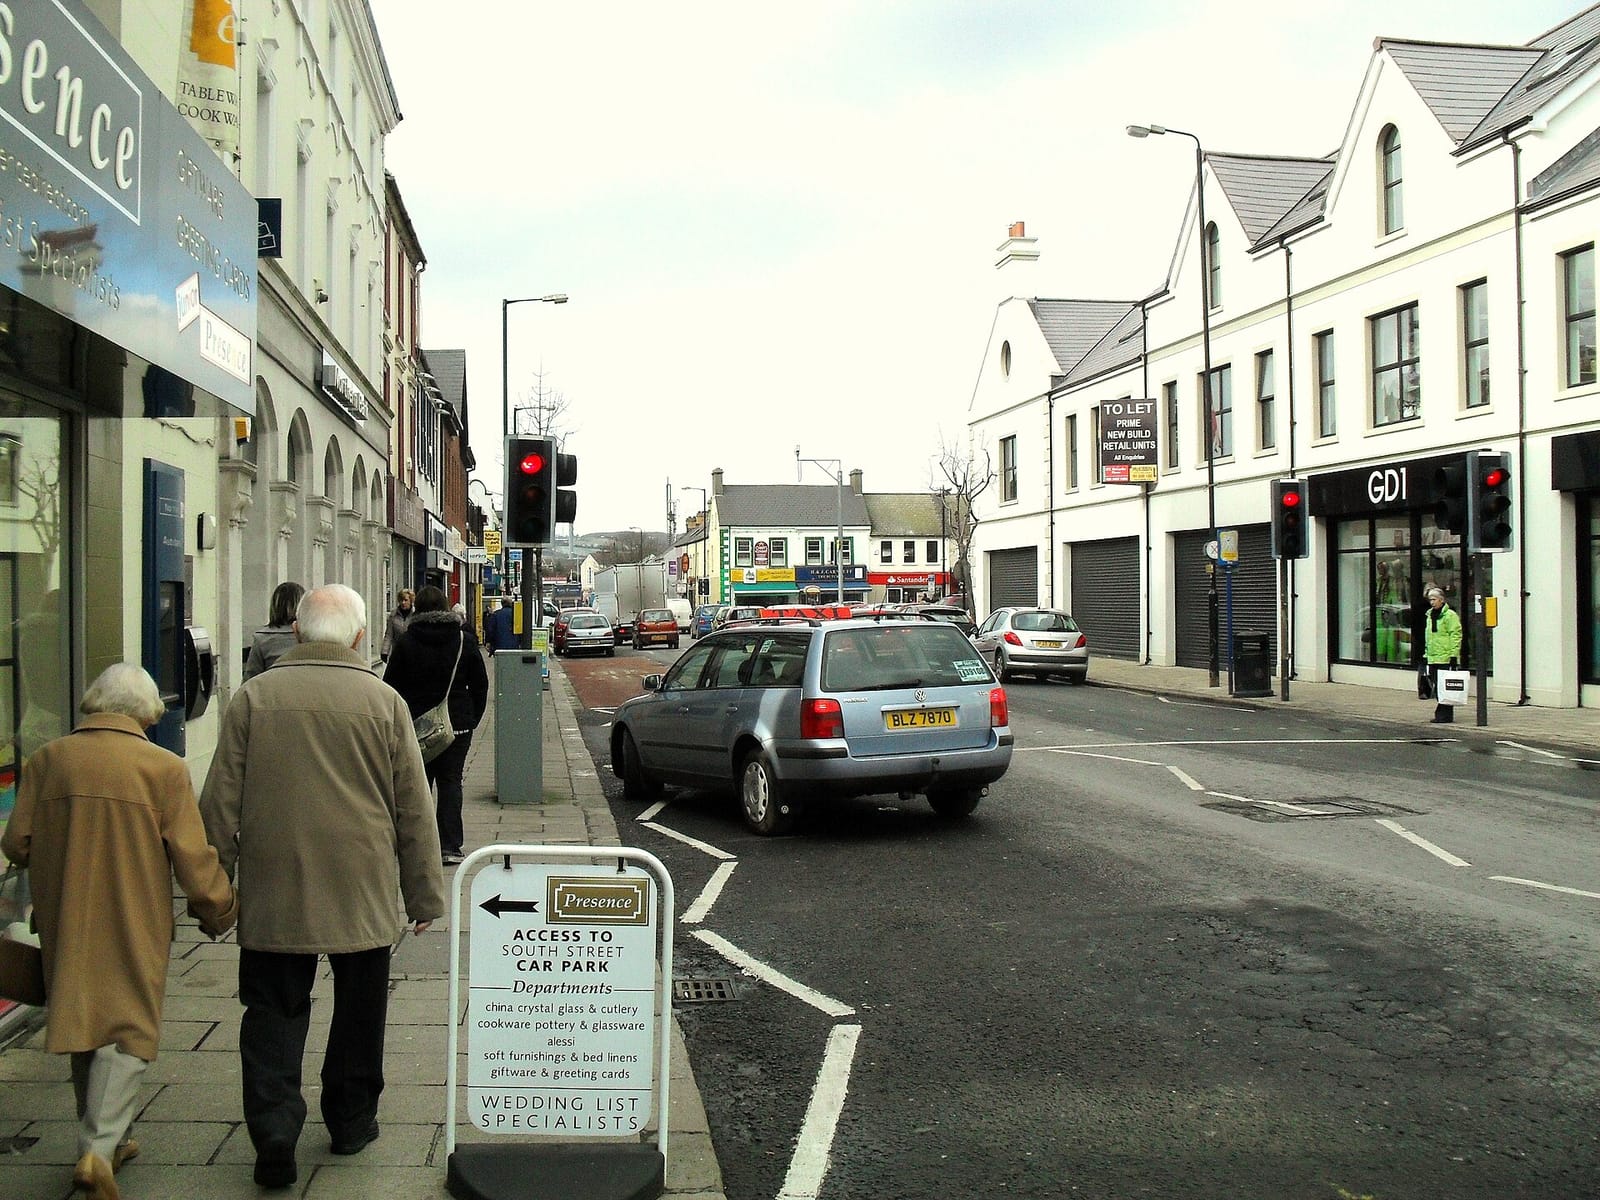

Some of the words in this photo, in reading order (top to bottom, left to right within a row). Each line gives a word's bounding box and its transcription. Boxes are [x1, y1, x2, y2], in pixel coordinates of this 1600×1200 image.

[180, 81, 238, 106] TABLEW
[176, 214, 221, 278] GREETING
[223, 256, 251, 302] CARDS
[28, 220, 121, 311] Specialists
[1104, 404, 1123, 415] TO
[1127, 402, 1154, 414] LET
[1116, 419, 1141, 428] PRIME
[1107, 430, 1126, 440] NEW
[1127, 430, 1151, 438] BUILD
[1103, 442, 1131, 450] RETAIL
[1132, 440, 1156, 450] UNITS
[896, 576, 929, 584] Santander
[772, 608, 838, 619] TAXI
[891, 713, 917, 727] BLZ
[919, 710, 951, 724] 7870
[563, 893, 632, 909] Presence
[513, 930, 581, 942] ACCESS
[589, 930, 613, 942] TO
[502, 944, 558, 957] SOUTH
[567, 946, 624, 958] STREET
[516, 960, 553, 972] CAR
[562, 960, 609, 973] PARK
[512, 980, 613, 997] Departments
[485, 1002, 513, 1012] china
[518, 1003, 554, 1015] crystal
[558, 1003, 584, 1016] glass
[588, 1004, 597, 1014] &
[601, 1003, 639, 1017] cutlery
[478, 1019, 531, 1030] cookware
[535, 1021, 576, 1032] pottery
[580, 1021, 588, 1030] &
[592, 1020, 645, 1033] glassware
[547, 1036, 576, 1047] alessi
[484, 1050, 505, 1061] soft
[510, 1051, 566, 1064] furnishings
[570, 1053, 579, 1062] &
[583, 1052, 603, 1063] bed
[608, 1052, 638, 1063] linens
[490, 1067, 536, 1079] giftware
[541, 1068, 549, 1078] &
[553, 1068, 597, 1081] greeting
[601, 1069, 630, 1080] cards
[481, 1095, 584, 1111] WEDDING
[596, 1097, 639, 1112] LIST
[481, 1114, 639, 1130] SPECIALISTS
